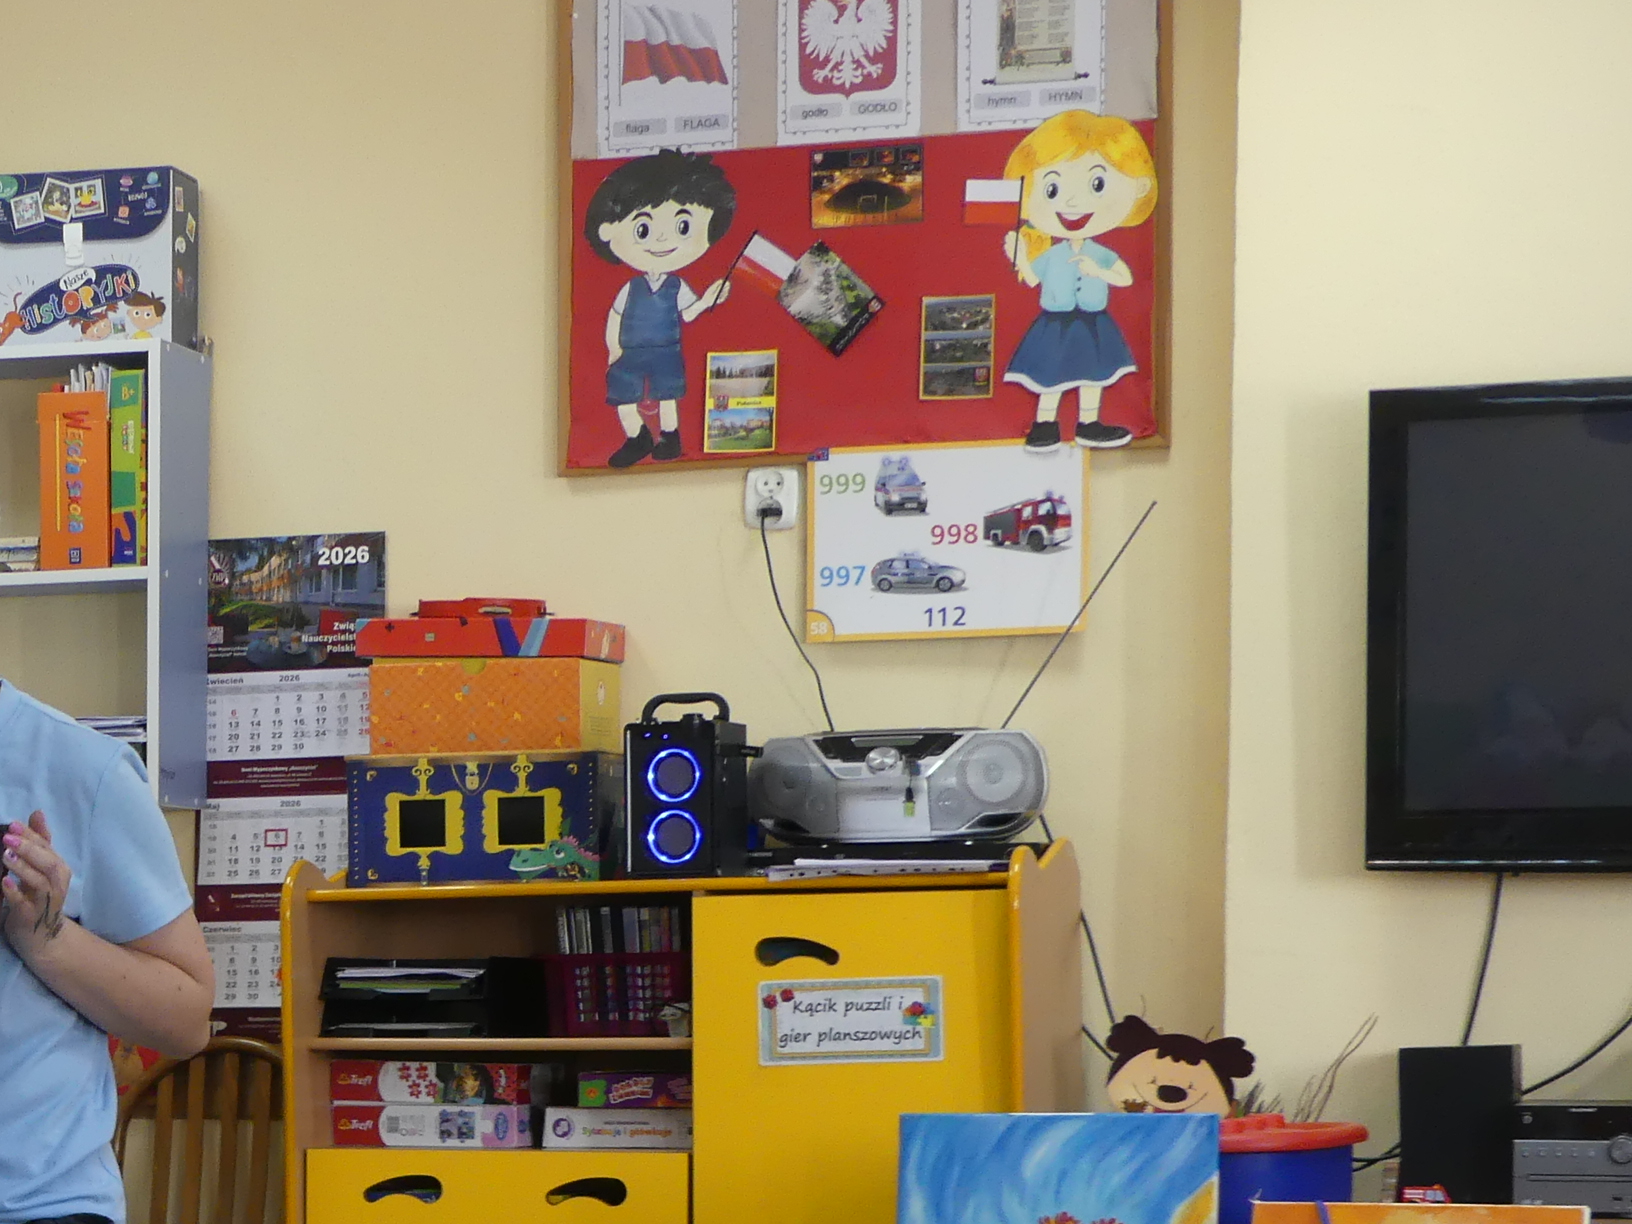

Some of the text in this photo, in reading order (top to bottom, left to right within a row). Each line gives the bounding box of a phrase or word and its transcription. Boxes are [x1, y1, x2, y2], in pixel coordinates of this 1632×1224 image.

[1049, 90, 1083, 101] HYMN
[626, 123, 649, 135] flaga
[683, 118, 720, 130] FLAGA
[63, 269, 88, 287] Nasze
[819, 473, 866, 494] 999
[931, 524, 978, 545] 998
[318, 546, 369, 565] 2026
[820, 565, 866, 587] 997
[924, 607, 966, 627] 112
[333, 622, 356, 632] Zwią
[810, 622, 827, 635] 58
[302, 633, 356, 643] Nauczycielst
[316, 705, 327, 713] 10
[250, 720, 261, 728] 14
[294, 718, 305, 726] 16
[315, 717, 327, 725] 17
[227, 745, 239, 753] 27
[792, 996, 904, 1017] Kącik puzzli i
[779, 1027, 923, 1048] gier planszowych
[351, 1074, 372, 1086] Trefl
[351, 1119, 373, 1130] Trefl
